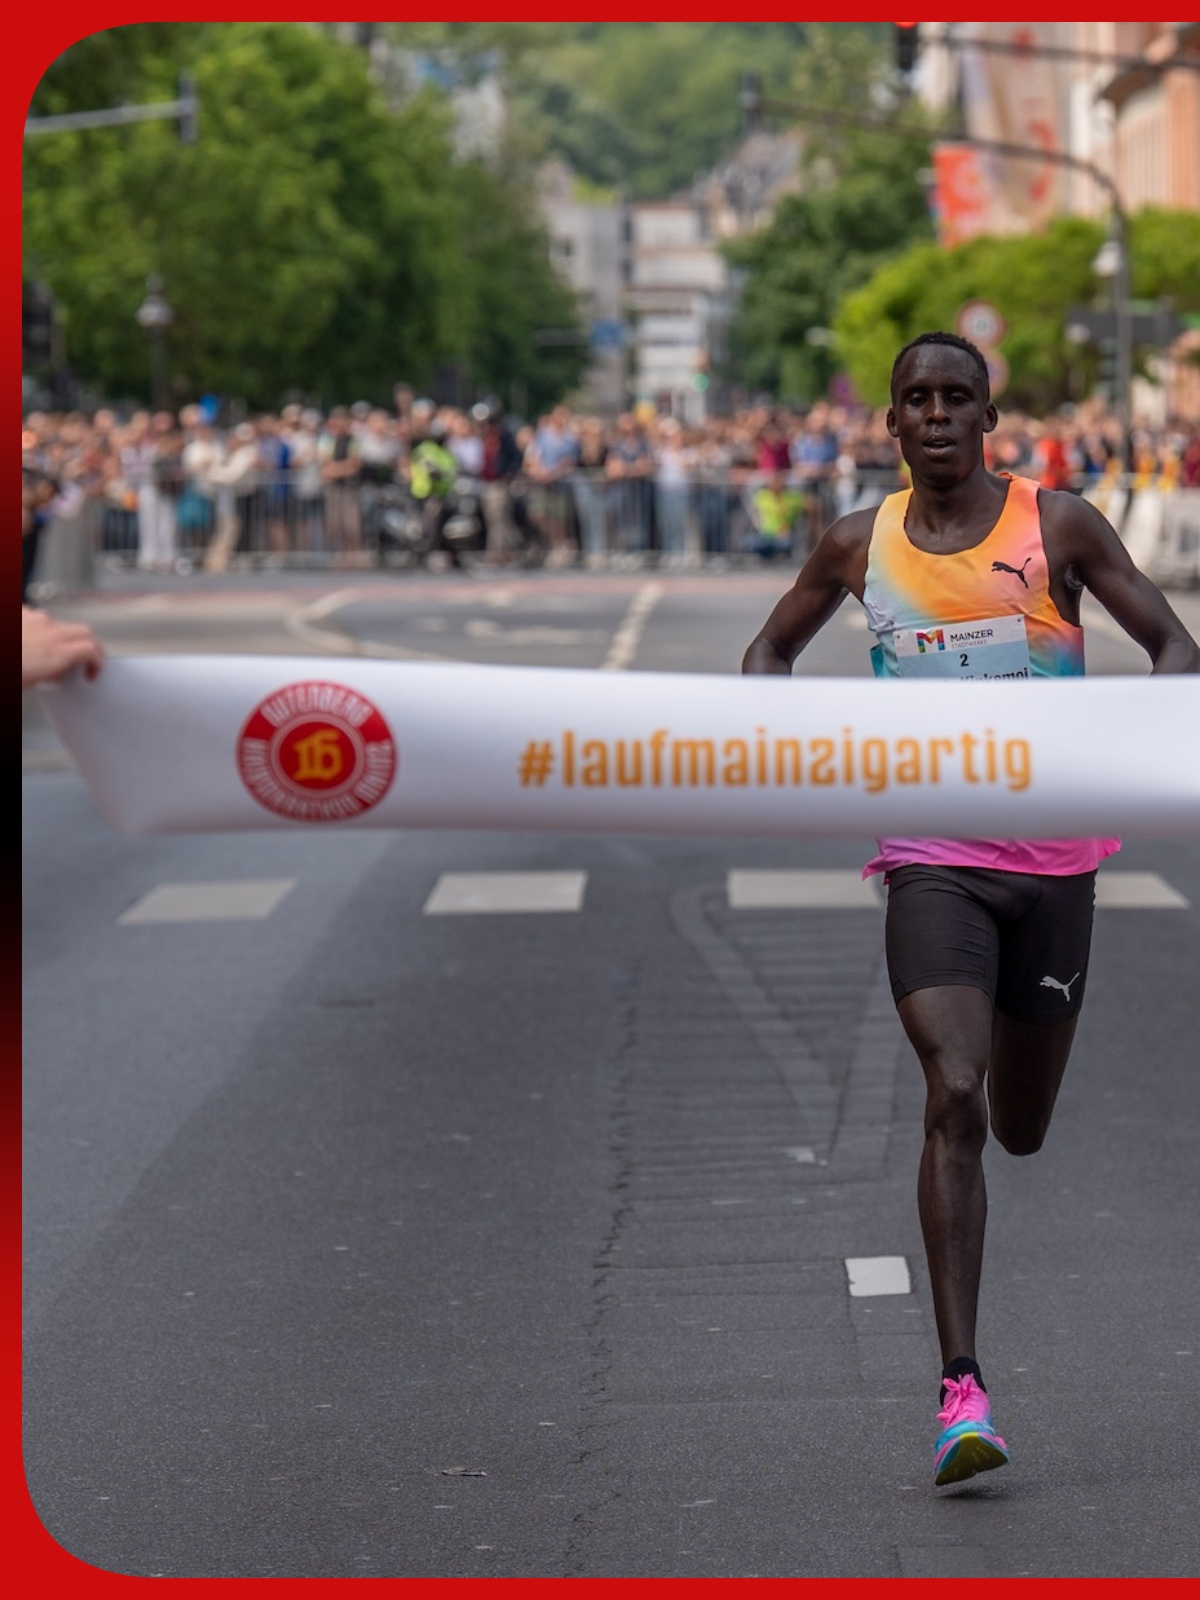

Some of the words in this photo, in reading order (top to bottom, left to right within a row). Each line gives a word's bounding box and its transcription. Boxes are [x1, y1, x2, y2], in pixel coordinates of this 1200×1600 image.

[950, 629, 993, 642] MAINZER
[959, 653, 969, 667] 2
[517, 726, 1033, 795] #laufmainzigartig
